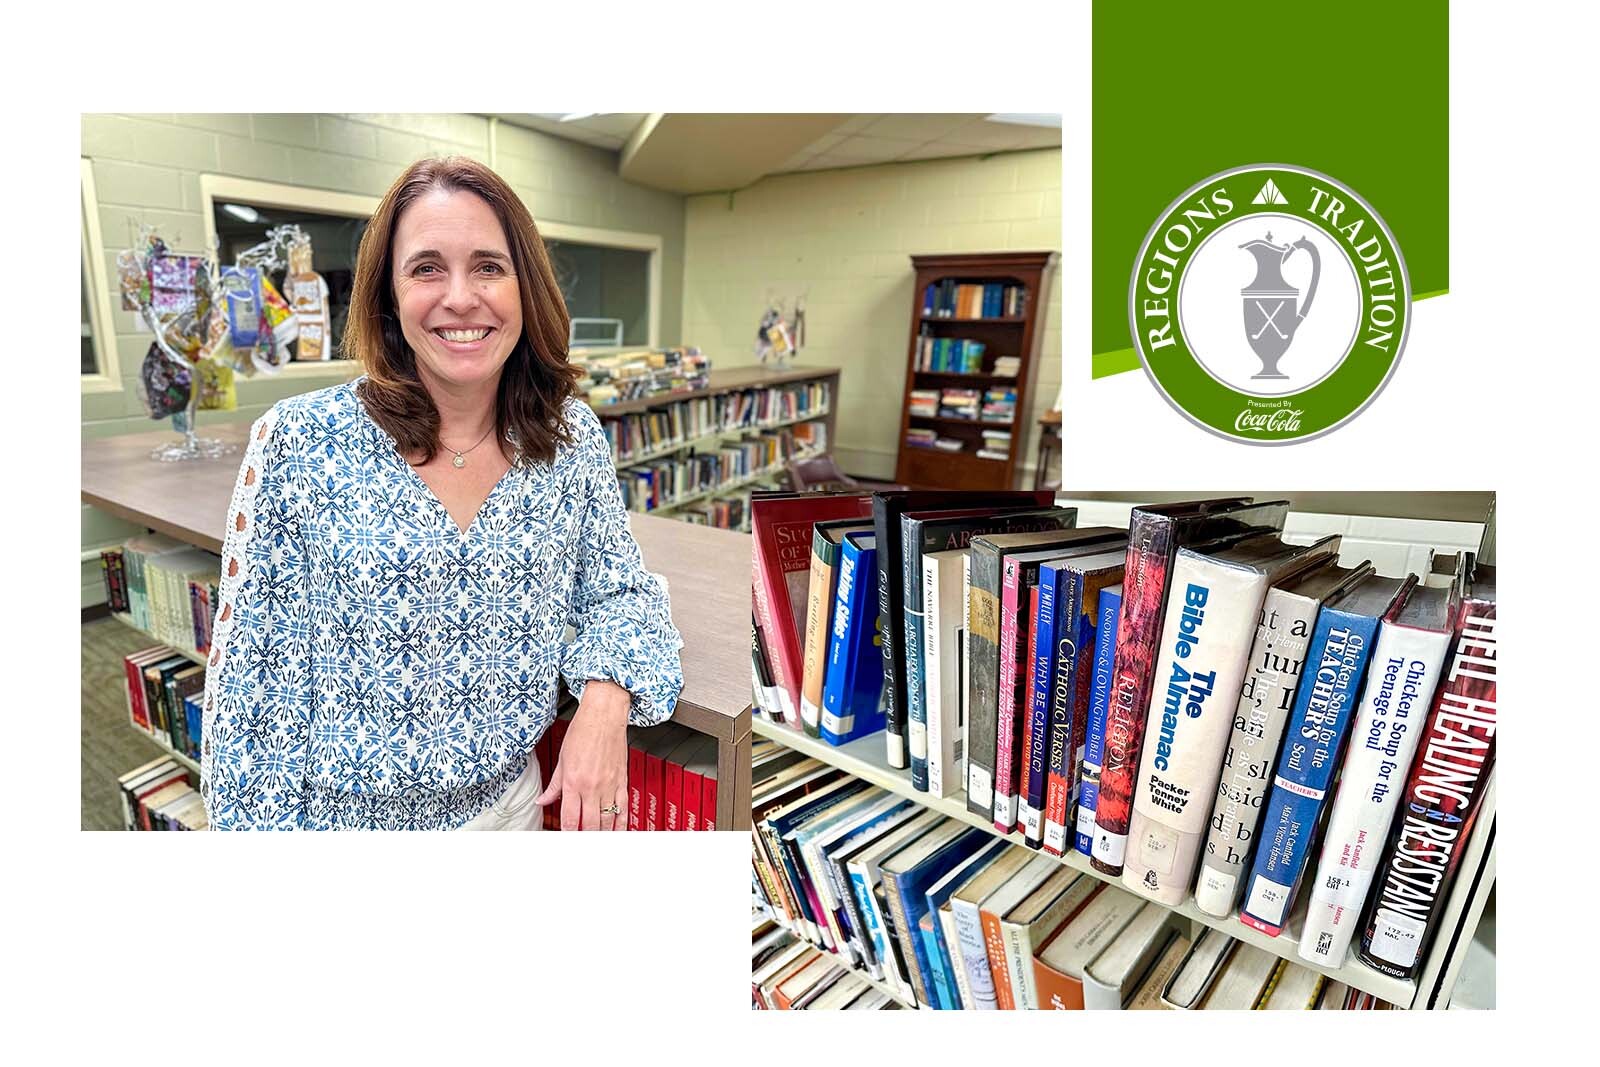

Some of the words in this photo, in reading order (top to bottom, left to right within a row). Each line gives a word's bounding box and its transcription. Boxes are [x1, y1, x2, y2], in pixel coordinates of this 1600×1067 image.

[837, 553, 855, 603] Taking
[1136, 538, 1151, 586] Levinson
[878, 569, 888, 614] History
[1040, 583, 1053, 625] O'MALLEY
[834, 599, 850, 640] Sides
[1101, 607, 1114, 657] KNOWING
[1175, 583, 1210, 659] Bible
[1290, 619, 1308, 638] a
[883, 624, 893, 660] Catholic
[1274, 634, 1304, 649] Henn
[1448, 616, 1496, 682] HELL
[1038, 656, 1048, 688] WHY
[1098, 657, 1109, 666] &
[1336, 634, 1364, 690] Chicken
[1054, 638, 1076, 720] CATHOLIC
[1094, 668, 1109, 716] LOVING
[1186, 670, 1217, 719] The
[1254, 668, 1280, 699] The
[1302, 627, 1351, 742] TEACHER'S
[1373, 657, 1405, 717] Teenage
[1396, 660, 1425, 719] Chicken
[1036, 691, 1046, 708] BE
[1325, 692, 1346, 726] Soup
[997, 685, 1006, 750] TESTAMENT
[1092, 717, 1102, 733] THE
[1109, 675, 1136, 776] RELIGION
[1154, 661, 1192, 772] Almanac
[1032, 710, 1045, 773] CATHOLIC?
[1051, 722, 1070, 770] VERSES
[1089, 734, 1101, 760] BIBLE
[1319, 729, 1336, 747] for
[1366, 719, 1386, 751] Soul
[1381, 722, 1407, 757] Soup
[1414, 692, 1496, 810] HEALING
[1238, 752, 1251, 769] as
[1287, 742, 1306, 771] Soul
[1312, 748, 1329, 768] the
[1378, 760, 1398, 781] for
[1149, 783, 1188, 807] Tenney
[1150, 774, 1190, 797] Packer
[1280, 780, 1318, 797] TEACHER'S
[1372, 782, 1390, 803] the
[1151, 794, 1183, 814] White
[1280, 805, 1292, 823] Mark
[1273, 824, 1287, 847] Victor
[1290, 820, 1301, 836] Jack
[1267, 848, 1280, 871] Hansen
[1281, 837, 1296, 866] Canfield
[1326, 882, 1339, 890] CHI
[1327, 875, 1350, 887] 158.1
[1380, 964, 1405, 977] PLOUGH
